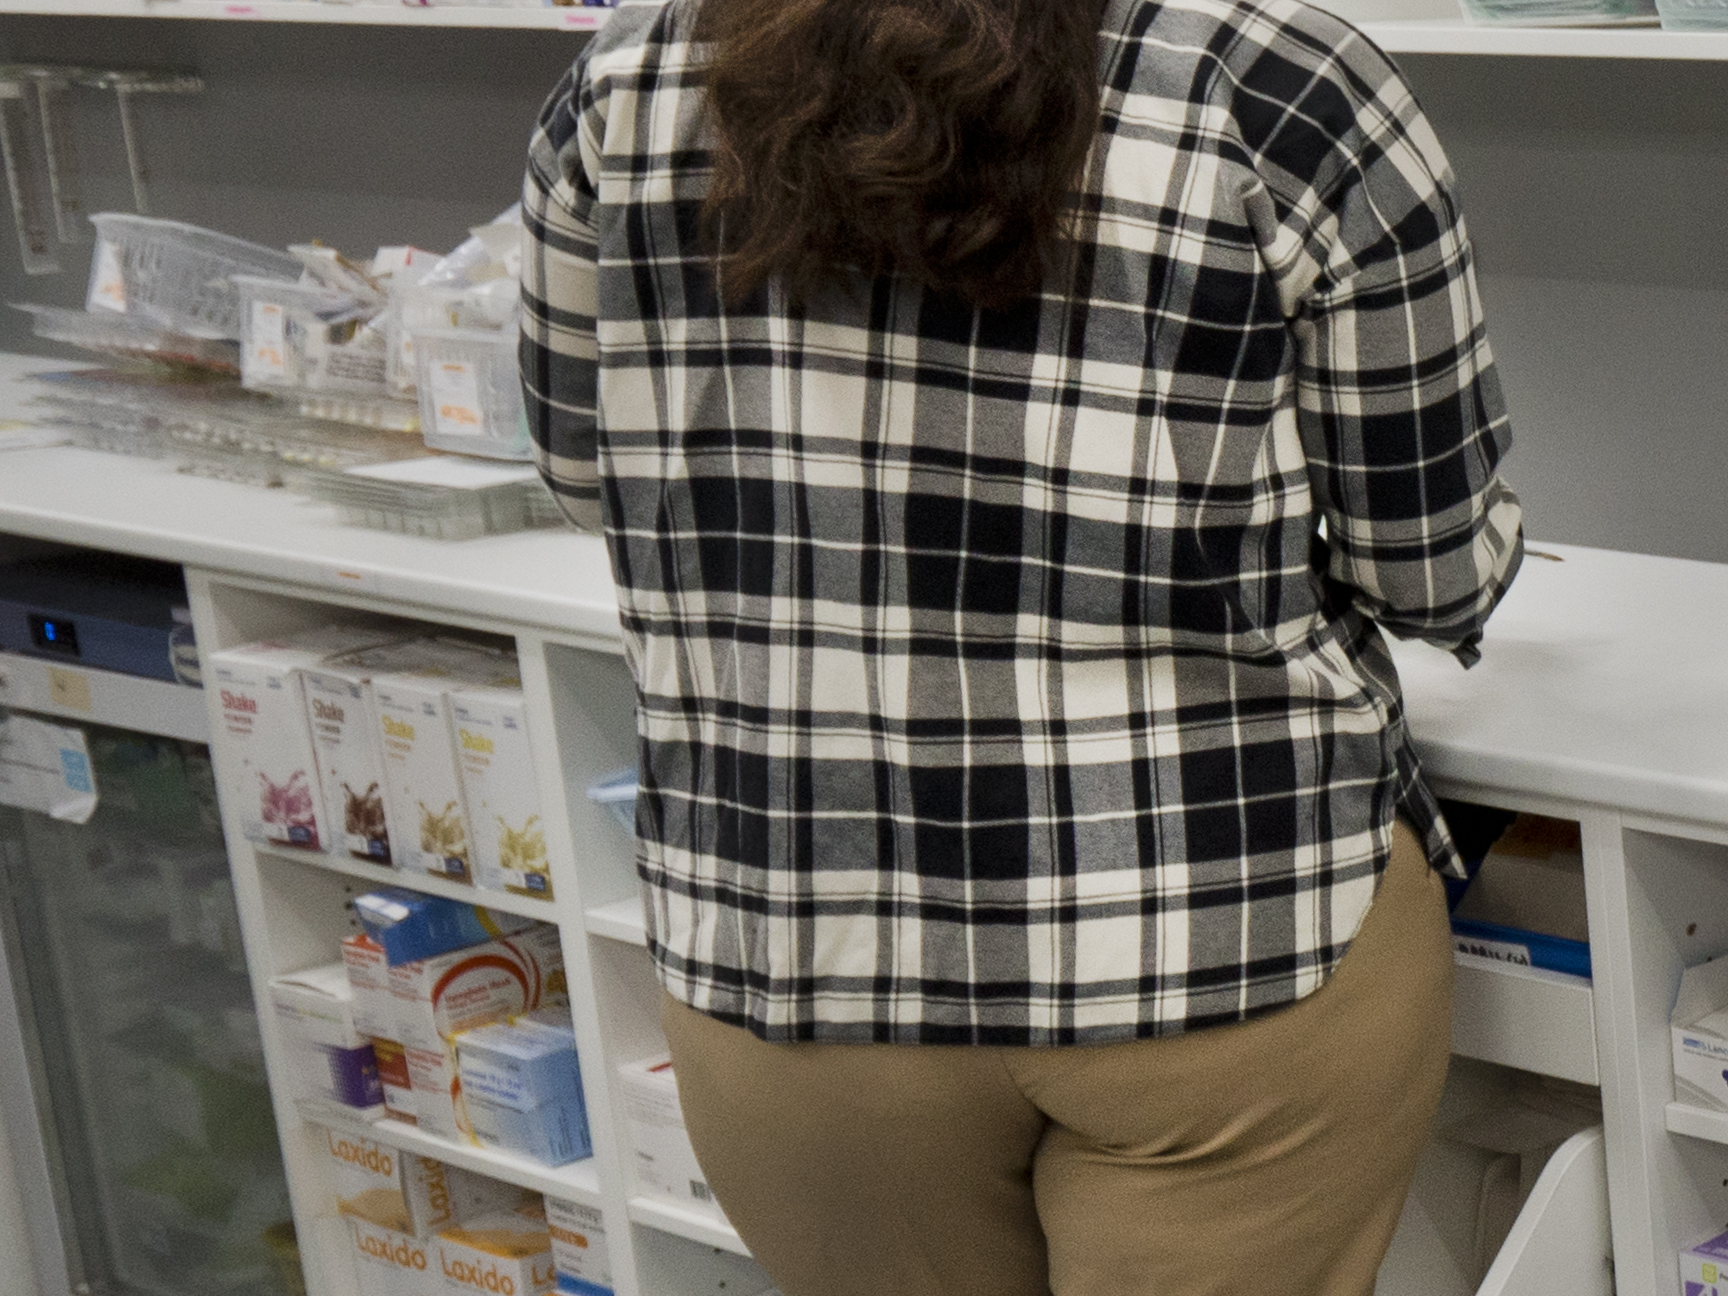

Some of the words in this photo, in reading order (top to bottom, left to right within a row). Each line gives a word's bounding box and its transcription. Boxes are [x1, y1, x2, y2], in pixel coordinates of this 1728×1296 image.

[220, 690, 257, 715] Shake
[327, 1127, 393, 1177] Laxido
[355, 1222, 428, 1271] Laxido
[439, 1247, 515, 1296] Laxido
